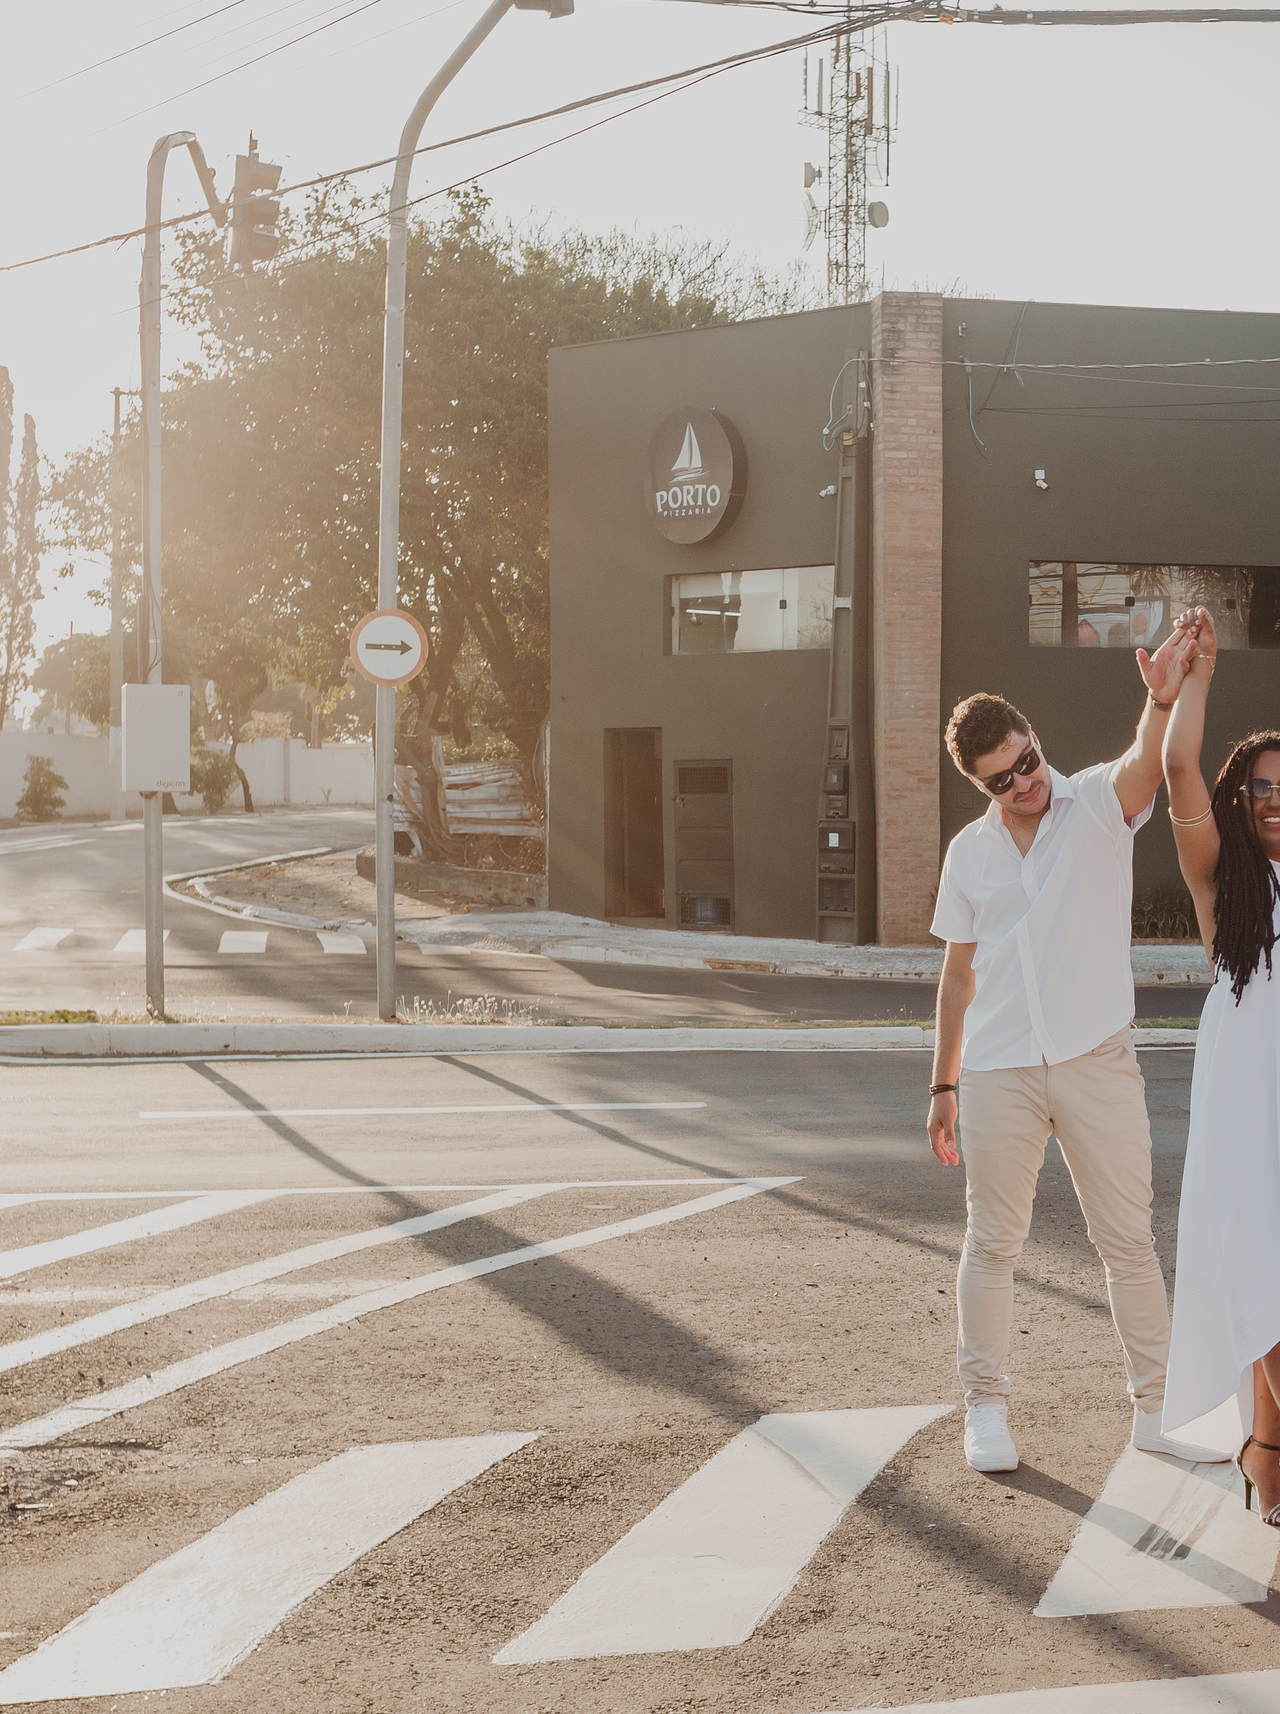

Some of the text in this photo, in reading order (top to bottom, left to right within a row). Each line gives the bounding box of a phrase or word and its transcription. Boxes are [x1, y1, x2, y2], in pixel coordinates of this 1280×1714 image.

[655, 484, 721, 513] PORTO
[663, 507, 711, 517] PIZZARIA
[156, 780, 186, 788] digicon
